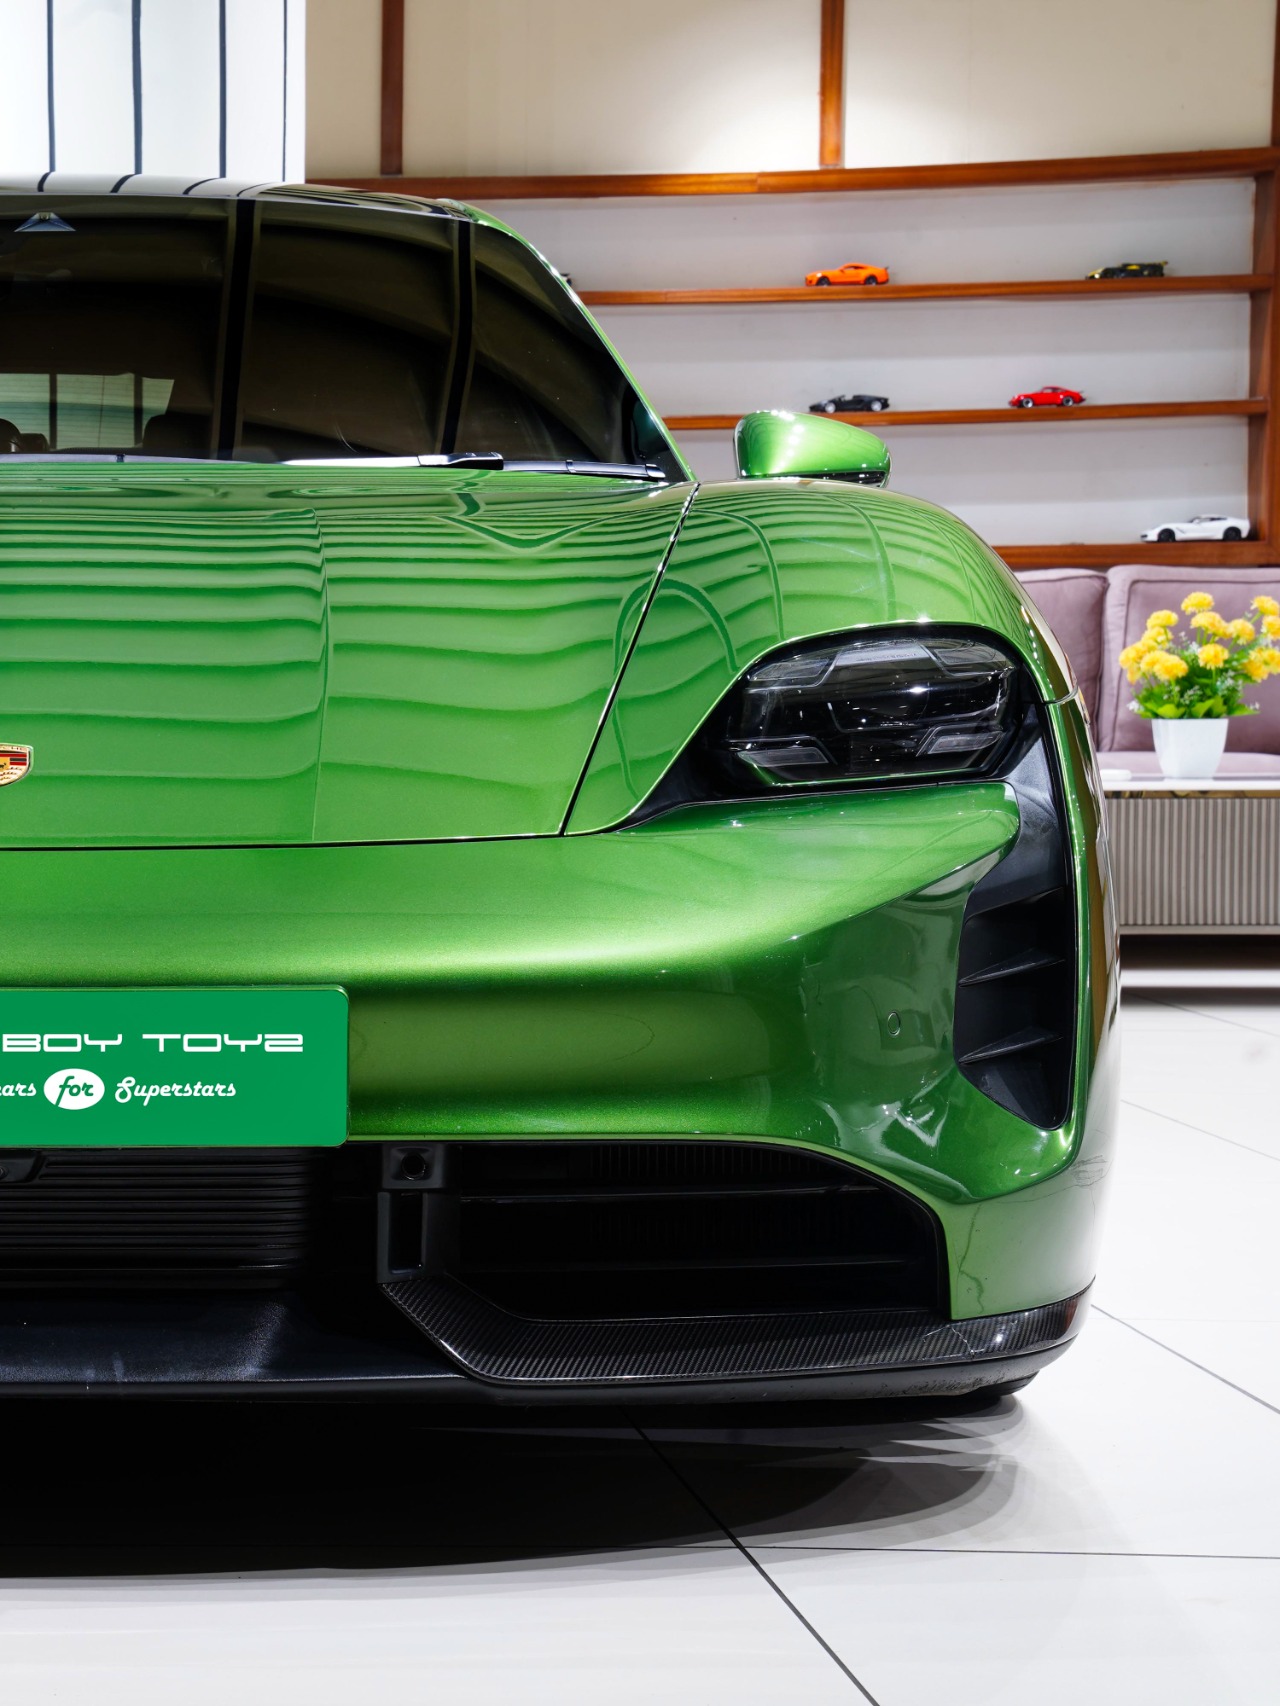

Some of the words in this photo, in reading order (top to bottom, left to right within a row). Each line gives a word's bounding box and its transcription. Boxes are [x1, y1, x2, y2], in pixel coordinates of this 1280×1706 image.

[2, 1033, 123, 1053] BOY
[142, 1033, 304, 1053] TOYZ
[55, 1075, 94, 1107] for
[115, 1076, 237, 1107] Superstars
